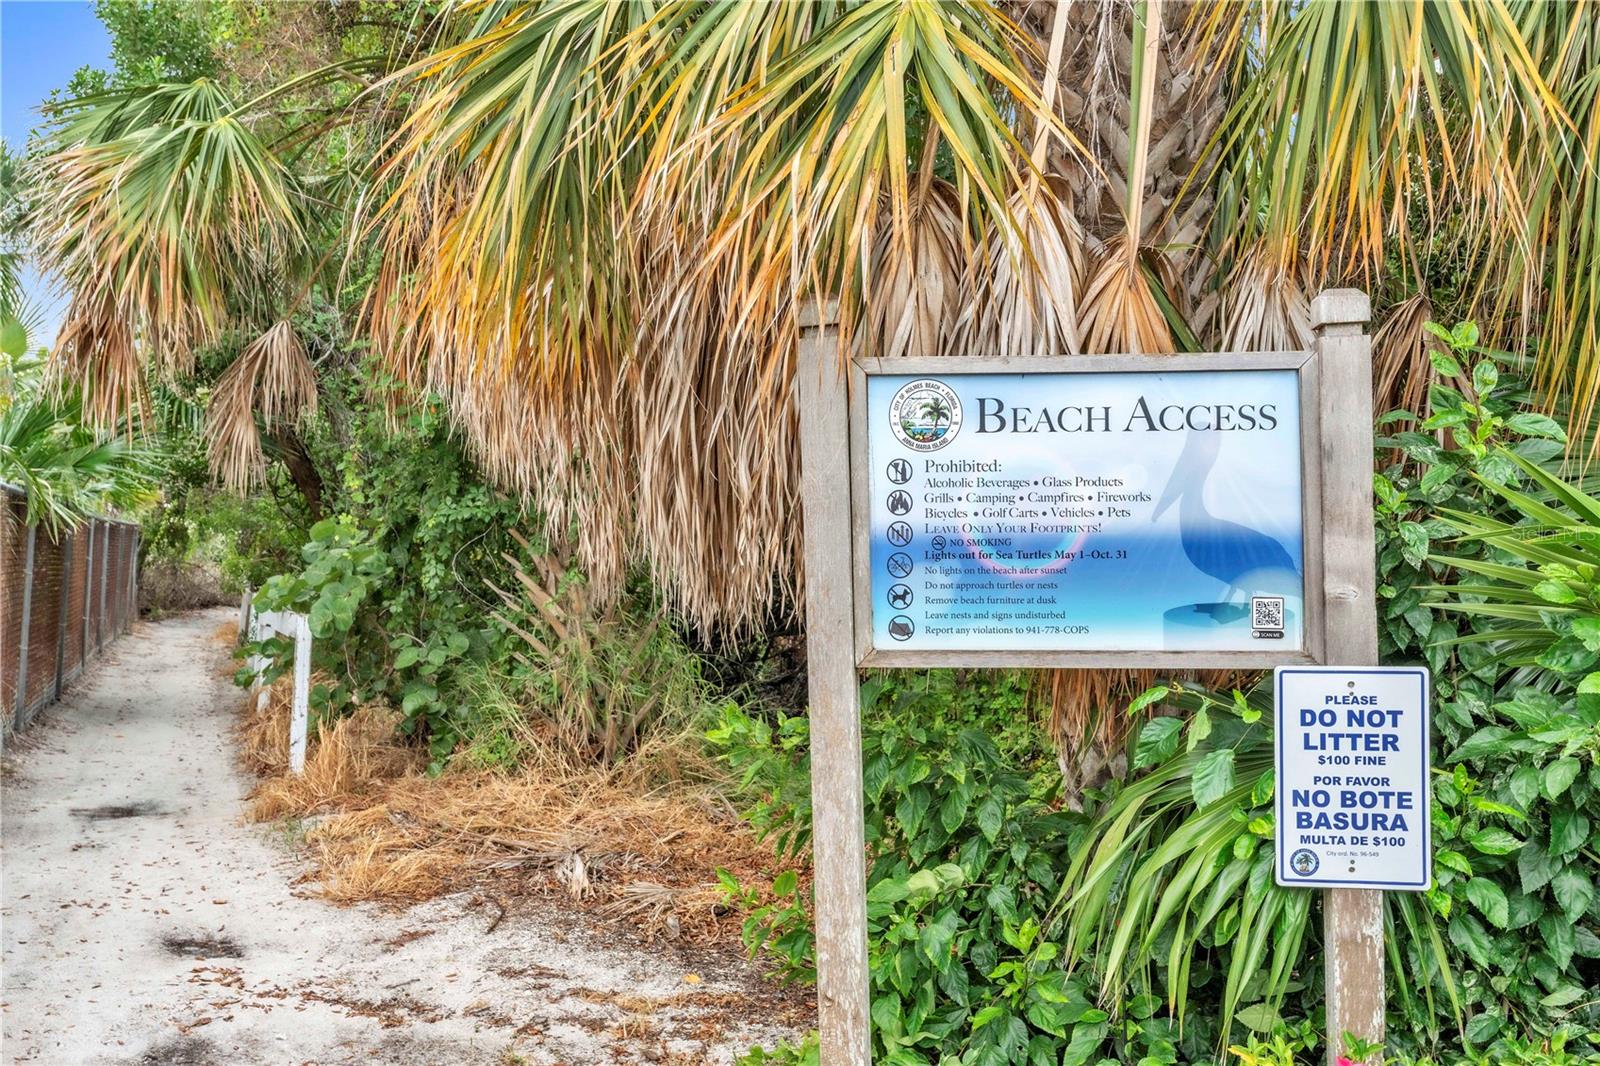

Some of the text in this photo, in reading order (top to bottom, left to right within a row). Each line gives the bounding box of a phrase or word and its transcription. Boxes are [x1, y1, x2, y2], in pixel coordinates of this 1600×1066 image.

[894, 400, 902, 411] CITY
[905, 382, 923, 394] HOLMES
[945, 391, 958, 409] FLORIDA
[975, 395, 1278, 434] BEACH ACCESS
[902, 437, 915, 448] ANNA
[931, 437, 949, 449] ISLAND
[925, 459, 1002, 473] Prohibited:
[924, 476, 1124, 490] Alcoholic Beverages Glass Products
[924, 491, 1152, 505] Grills Camping Campfires Fireworks
[925, 506, 1131, 521] Bicycles Golf Carts Vehicles Pets
[925, 522, 1102, 534] LEAVE ONLY YOUR FOOTPRINTS!
[950, 537, 1012, 547] NO SMOKING
[925, 550, 957, 562] Lights
[959, 551, 976, 560] out
[978, 550, 993, 560] for
[996, 550, 1013, 560] Sea
[1016, 550, 1052, 560] Turtles
[1055, 550, 1077, 562] May
[1116, 550, 1127, 559] 31
[925, 566, 938, 575] No
[939, 566, 962, 577] lights
[977, 566, 991, 574] the
[993, 566, 1017, 574] beach
[1019, 566, 1038, 574] after
[1040, 566, 1067, 574] sunset
[925, 581, 938, 590] Do
[940, 582, 954, 590] not
[956, 581, 994, 592] approach
[996, 581, 1024, 590] turtles
[1037, 582, 1058, 590] nests
[925, 596, 959, 605] Remove
[960, 596, 985, 605] beach
[987, 595, 1025, 605] furniture
[1036, 596, 1057, 605] dusk
[925, 610, 1066, 622] Leave nests and signs undisturbed
[925, 626, 1090, 637] Report any violations to 941-778-COPS
[1325, 695, 1378, 705] PLEASE
[1299, 709, 1404, 728] DO NOT
[1303, 733, 1400, 752] LITTER
[1318, 755, 1387, 766] $100 FINE
[1313, 776, 1391, 787] POR FAVOR
[1292, 789, 1413, 810] NO BOTE
[1296, 811, 1409, 832] BASURA
[1300, 835, 1406, 847] MULTA DE $100
